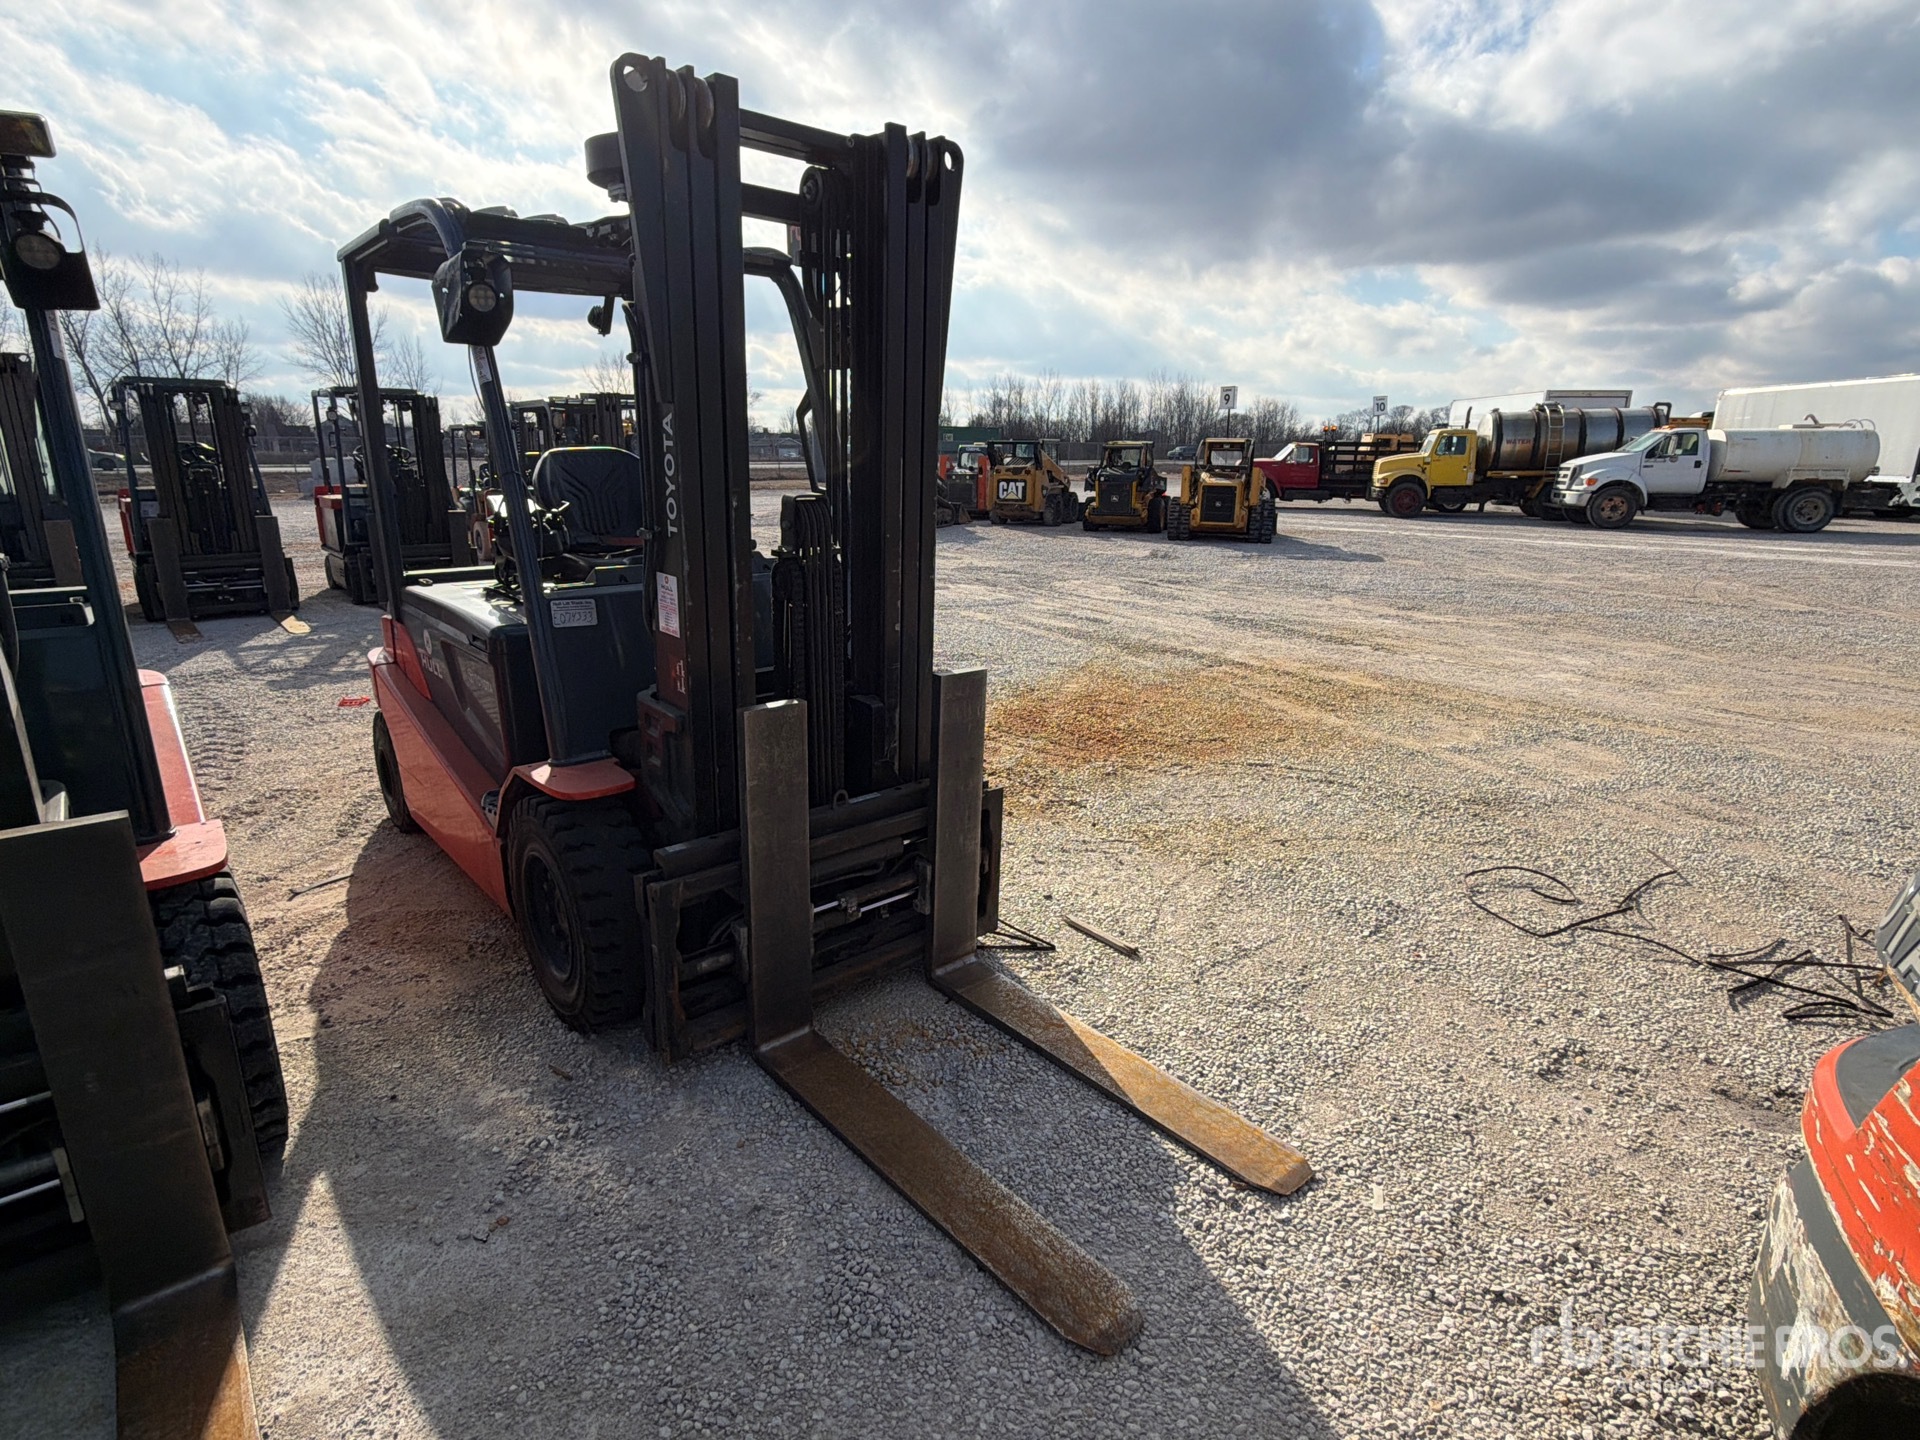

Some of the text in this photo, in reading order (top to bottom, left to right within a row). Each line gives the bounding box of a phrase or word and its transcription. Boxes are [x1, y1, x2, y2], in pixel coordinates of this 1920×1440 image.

[1224, 393, 1231, 405] 9
[1376, 402, 1386, 412] 10
[662, 413, 678, 537] TOYOTA
[998, 481, 1025, 500] CAT
